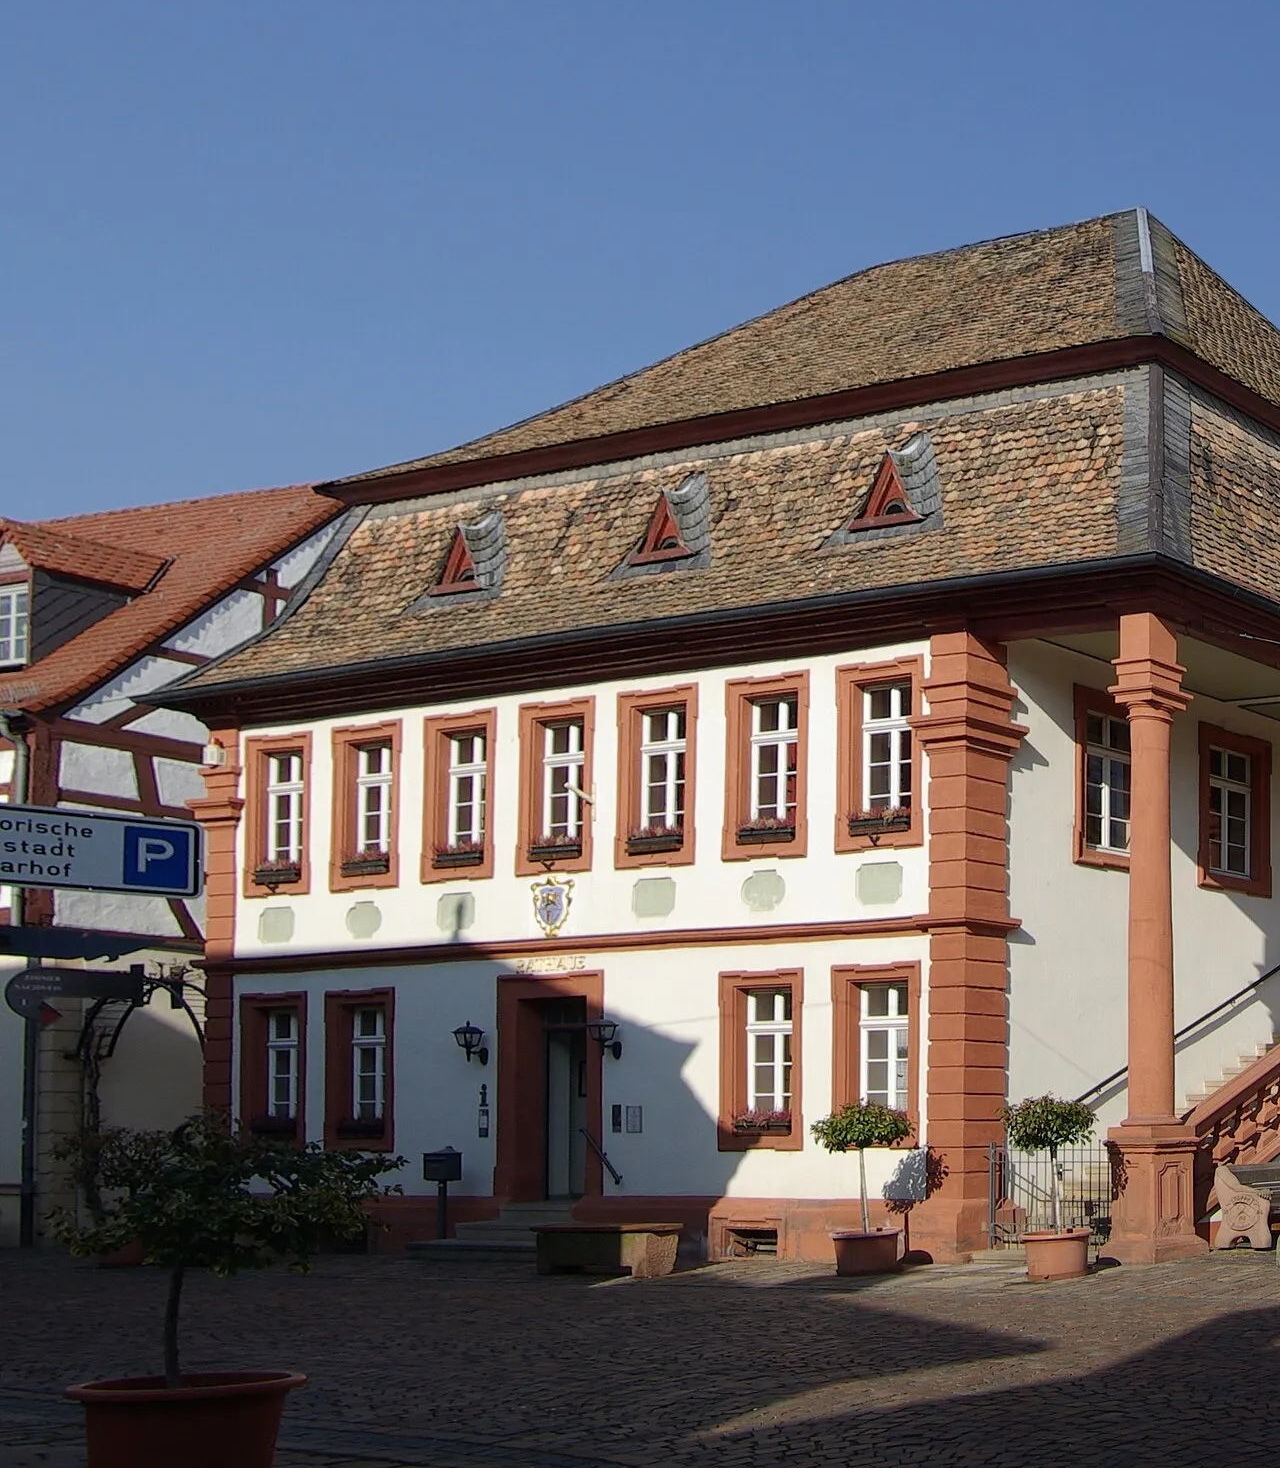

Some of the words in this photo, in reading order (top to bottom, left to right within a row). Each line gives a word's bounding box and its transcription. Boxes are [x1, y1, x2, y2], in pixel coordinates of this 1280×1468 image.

[0, 840, 76, 858] stadt
[137, 837, 174, 873] P
[515, 956, 587, 974] RATHAUS
